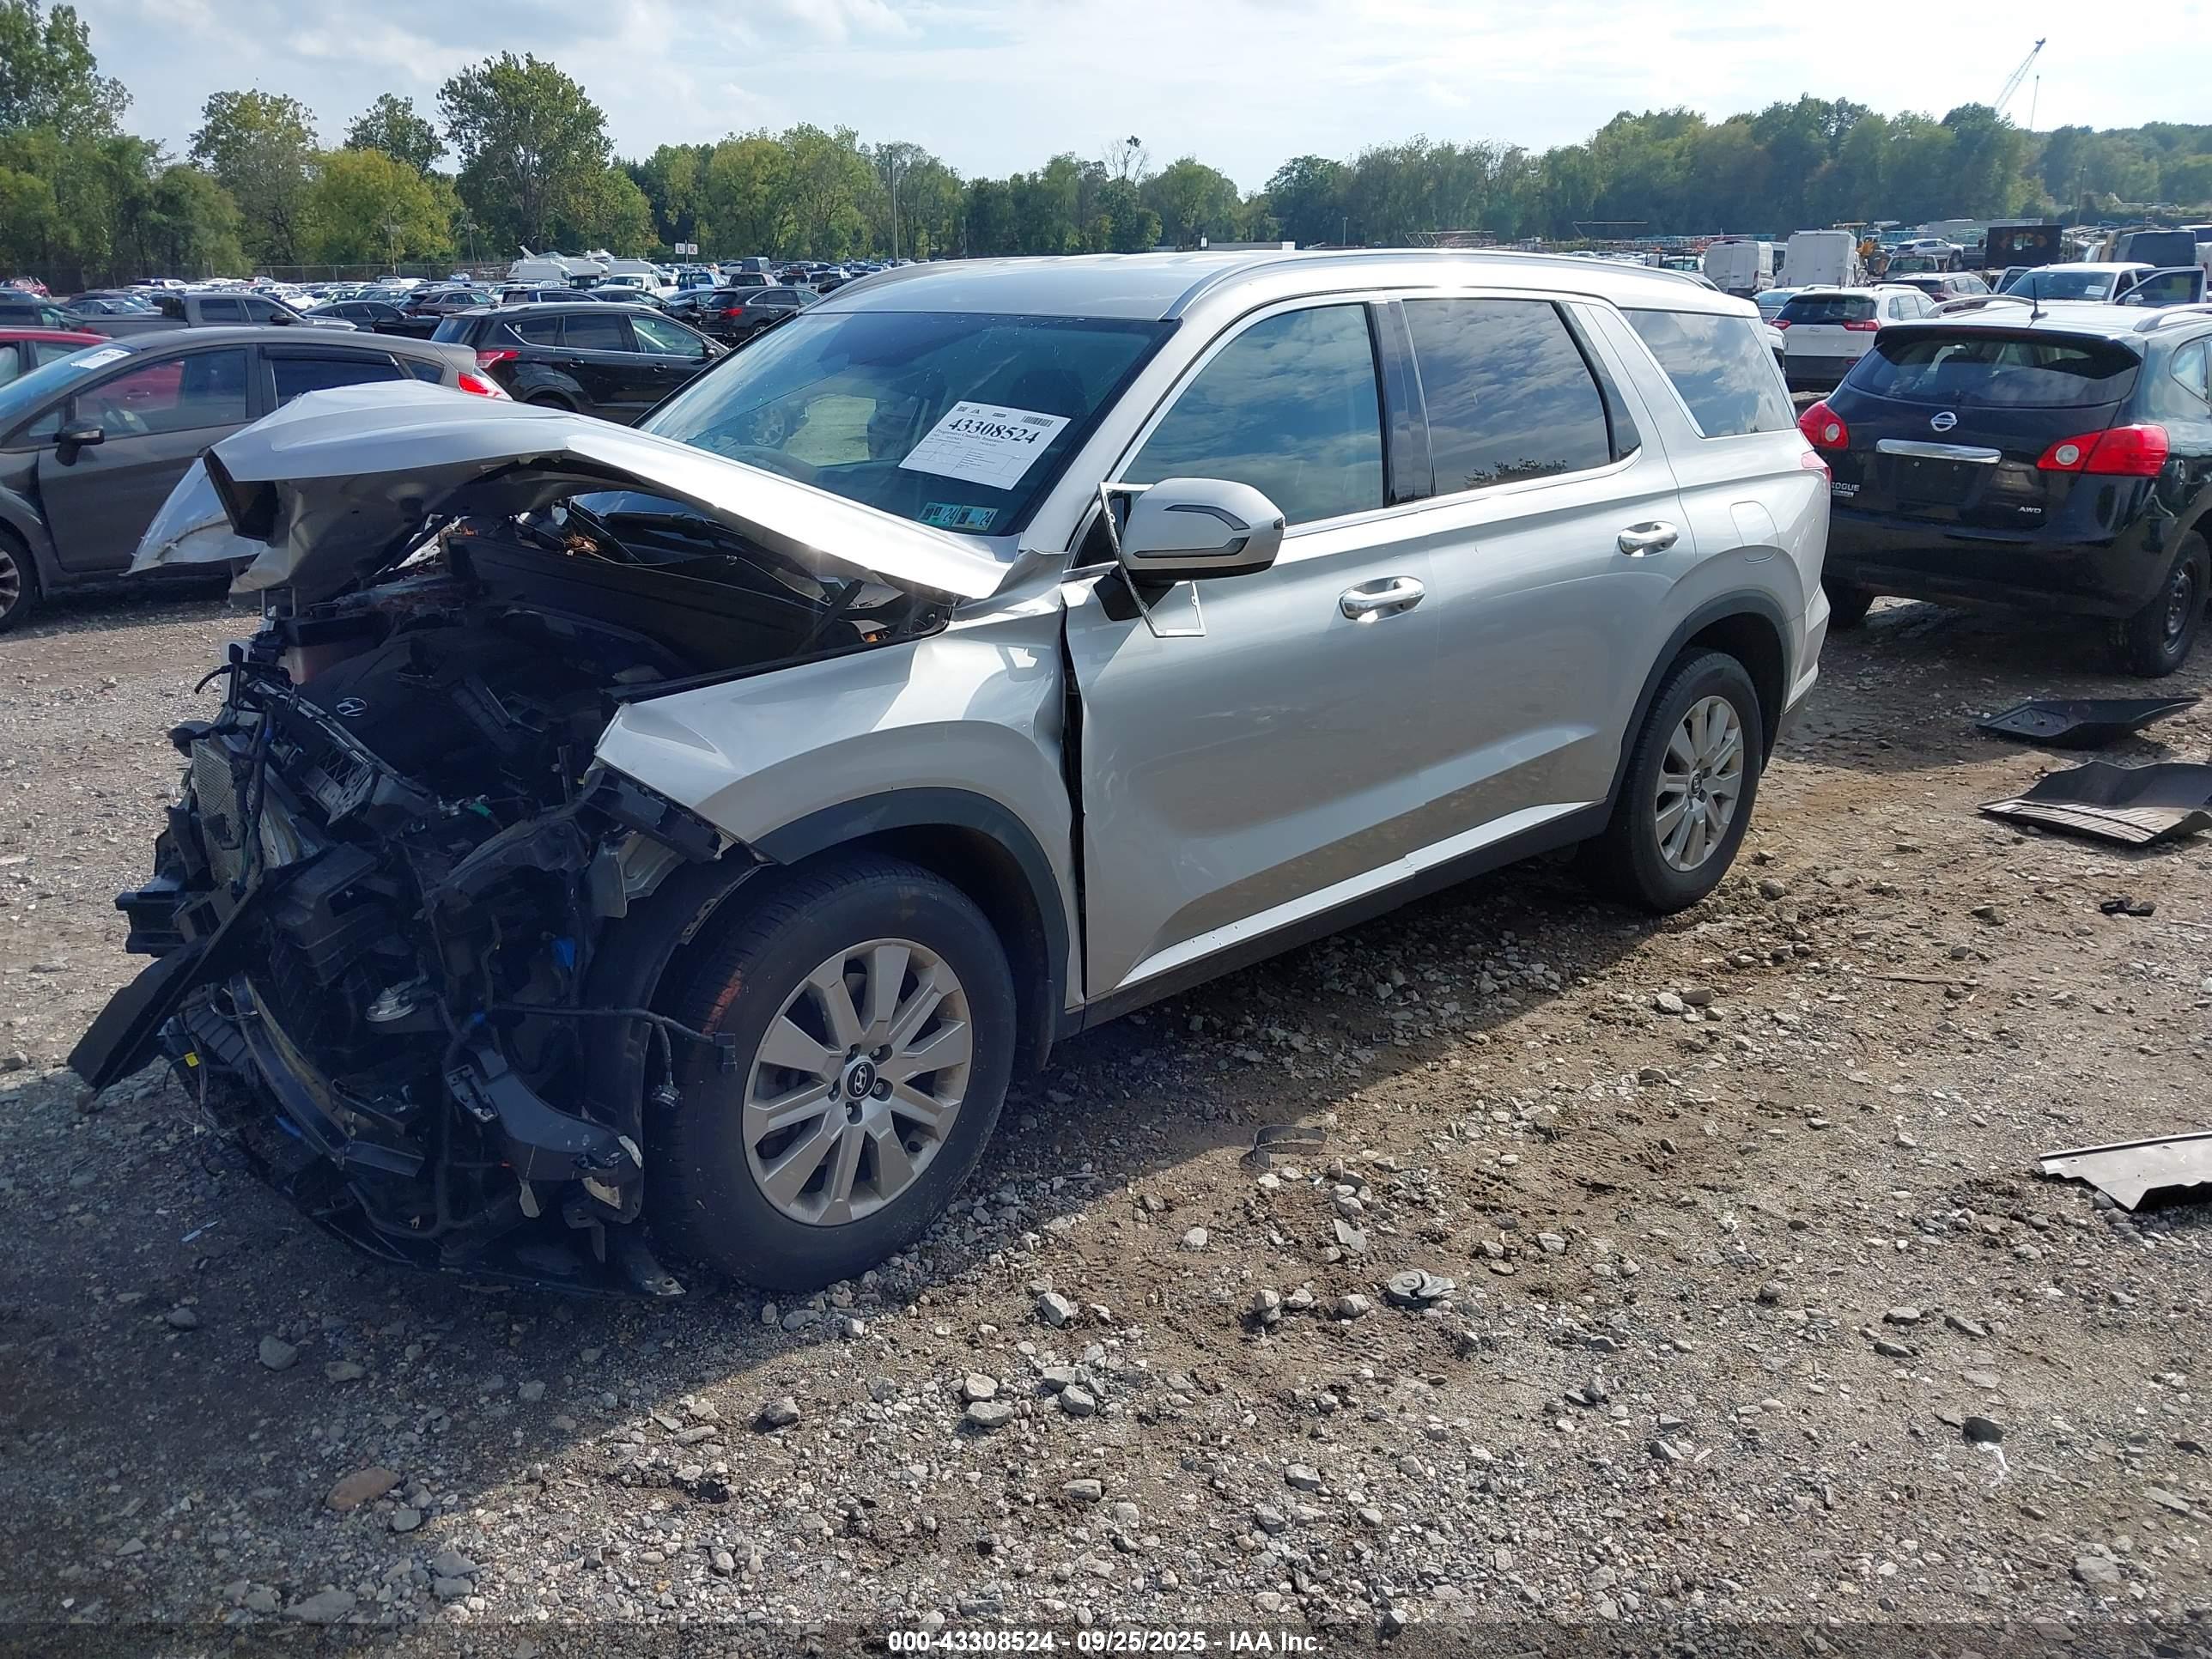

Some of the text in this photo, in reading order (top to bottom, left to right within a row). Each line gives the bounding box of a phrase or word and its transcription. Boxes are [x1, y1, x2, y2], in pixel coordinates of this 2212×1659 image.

[690, 245, 696, 253] K
[948, 417, 1041, 444] 43308524
[942, 507, 959, 523] 24
[979, 510, 995, 526] 24
